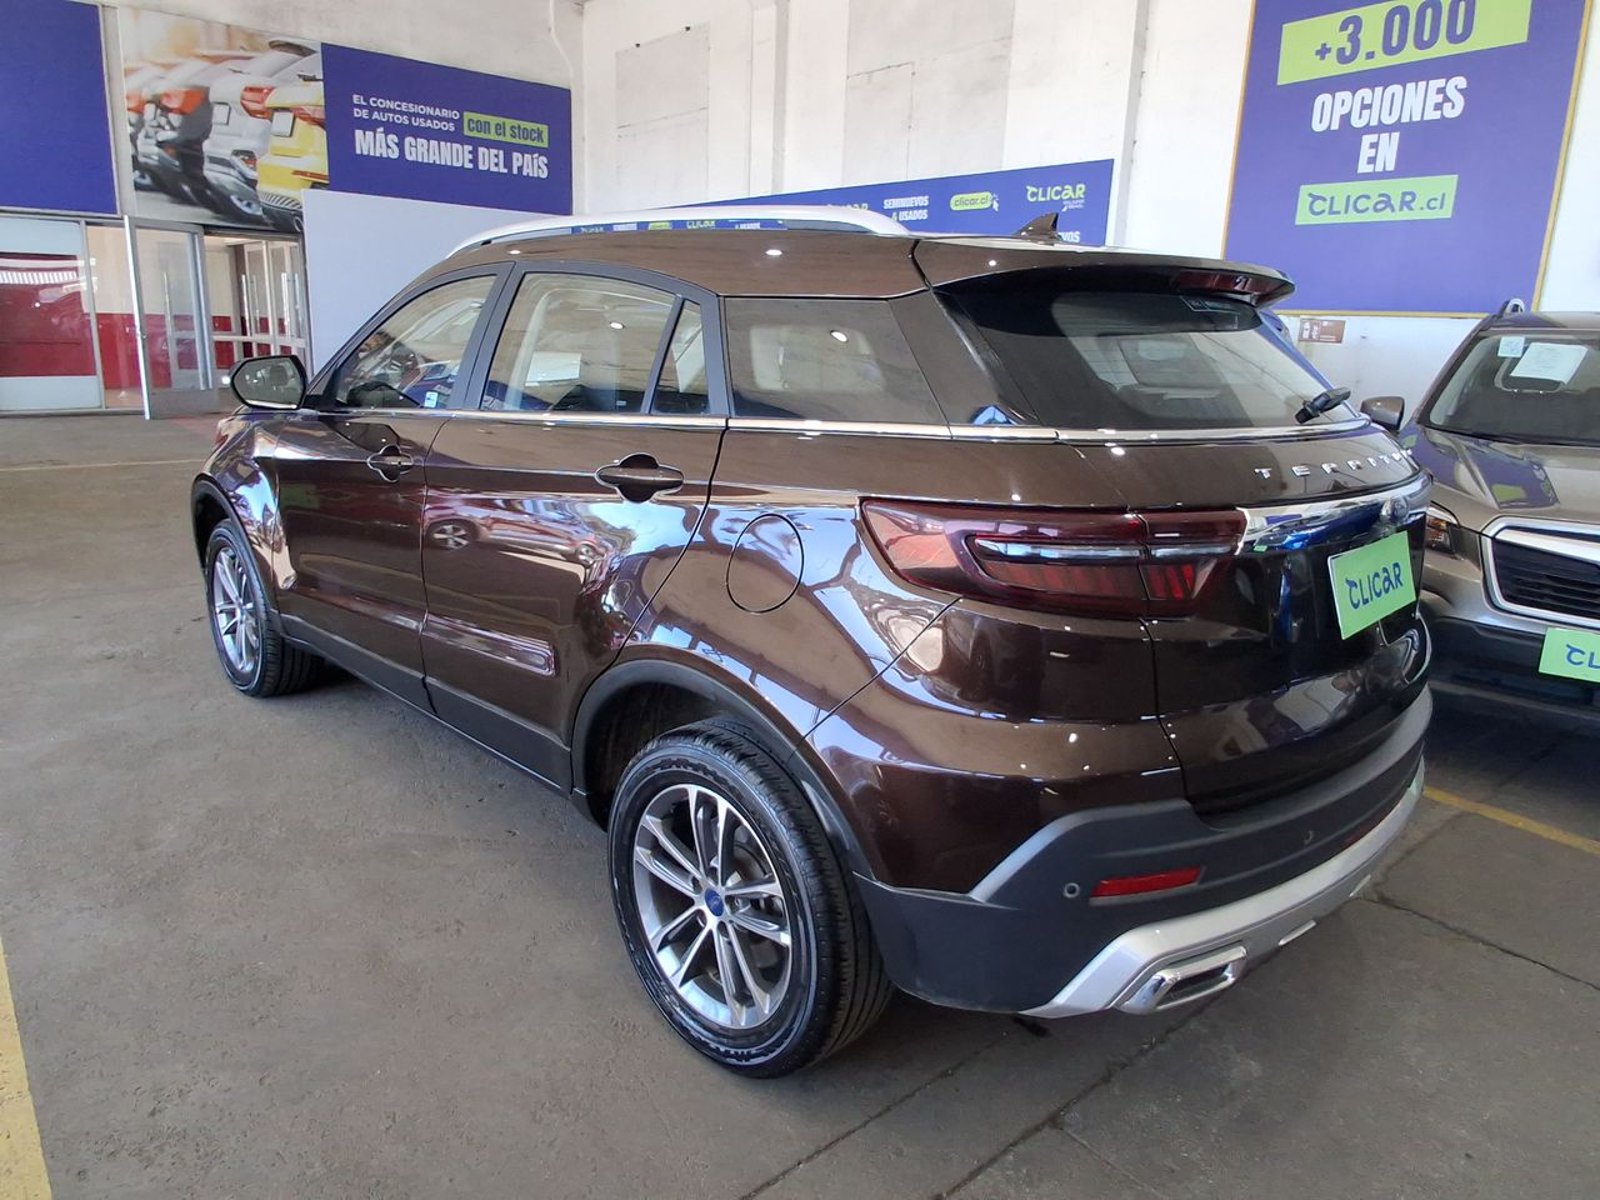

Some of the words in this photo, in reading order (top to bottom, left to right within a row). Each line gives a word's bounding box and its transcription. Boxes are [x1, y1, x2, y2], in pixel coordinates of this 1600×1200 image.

[1314, 0, 1476, 65] +3.000
[353, 94, 367, 105] EL
[369, 97, 460, 120] CONCESIONARIO
[353, 108, 369, 120] DE
[372, 110, 409, 125] AUTOS
[412, 116, 455, 131] USADOS
[1311, 76, 1468, 132] OPCIONES
[467, 118, 491, 135] con
[495, 122, 506, 137] el
[510, 123, 544, 143] stock
[354, 127, 400, 159] MÁS
[404, 136, 474, 169] GRANDE
[478, 146, 508, 173] DEL
[512, 152, 549, 179] PAÍS
[1357, 131, 1400, 174] EN
